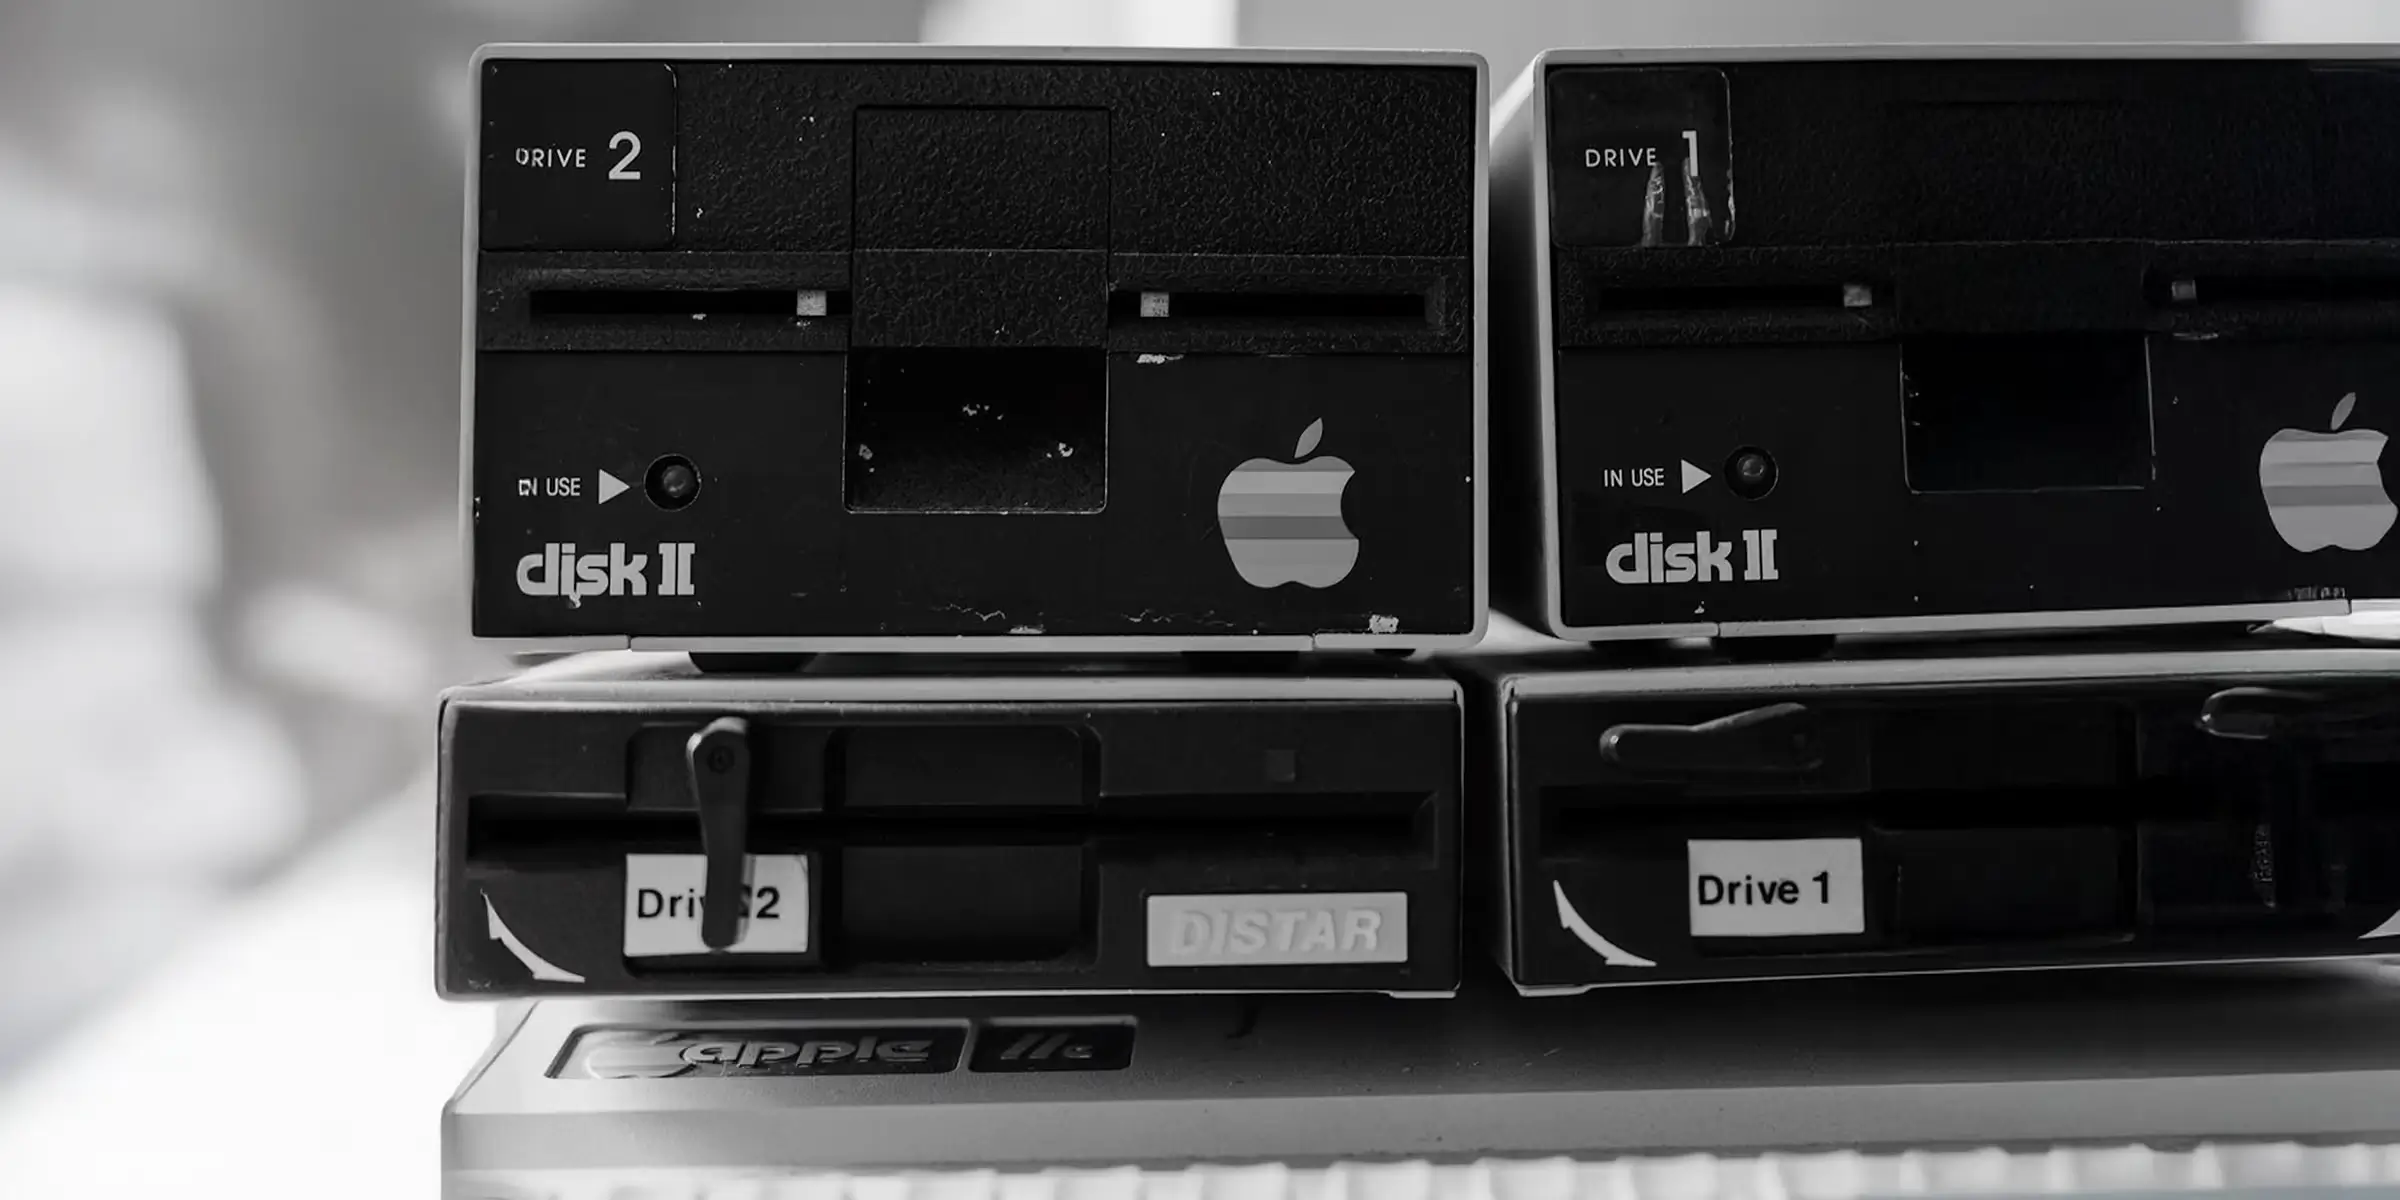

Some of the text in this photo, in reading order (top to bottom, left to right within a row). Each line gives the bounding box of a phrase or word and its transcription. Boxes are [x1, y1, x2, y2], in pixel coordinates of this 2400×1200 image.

[515, 130, 642, 181] DRIVE 2
[1584, 129, 1699, 177] DRIVE 1
[546, 477, 581, 496] USE
[1603, 467, 1665, 488] IN USE
[516, 542, 648, 603] disk
[1605, 530, 1734, 585] disk
[756, 886, 781, 919] 2
[1698, 871, 1829, 905] Drive 1
[1168, 908, 1383, 954] DISTAR
[680, 1036, 934, 1068] apple
